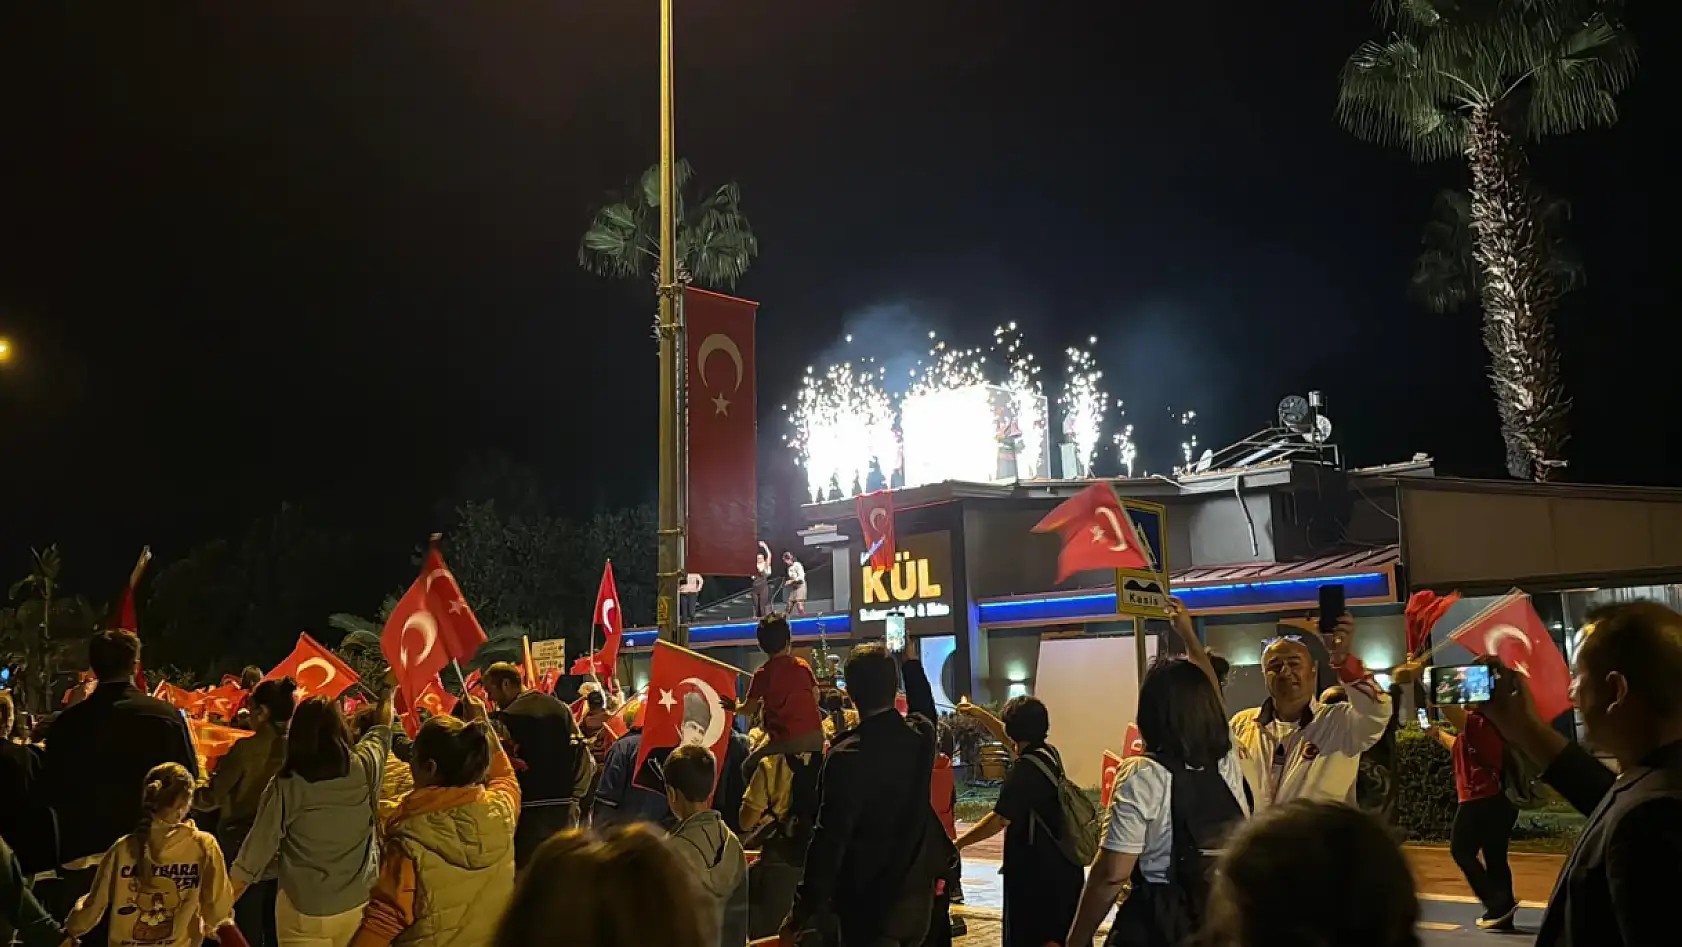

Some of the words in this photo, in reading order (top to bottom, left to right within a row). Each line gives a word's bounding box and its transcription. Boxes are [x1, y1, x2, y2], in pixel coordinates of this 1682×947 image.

[863, 551, 942, 604] KÜL
[1129, 592, 1159, 606] Kasis
[121, 864, 199, 878] CAYBARA
